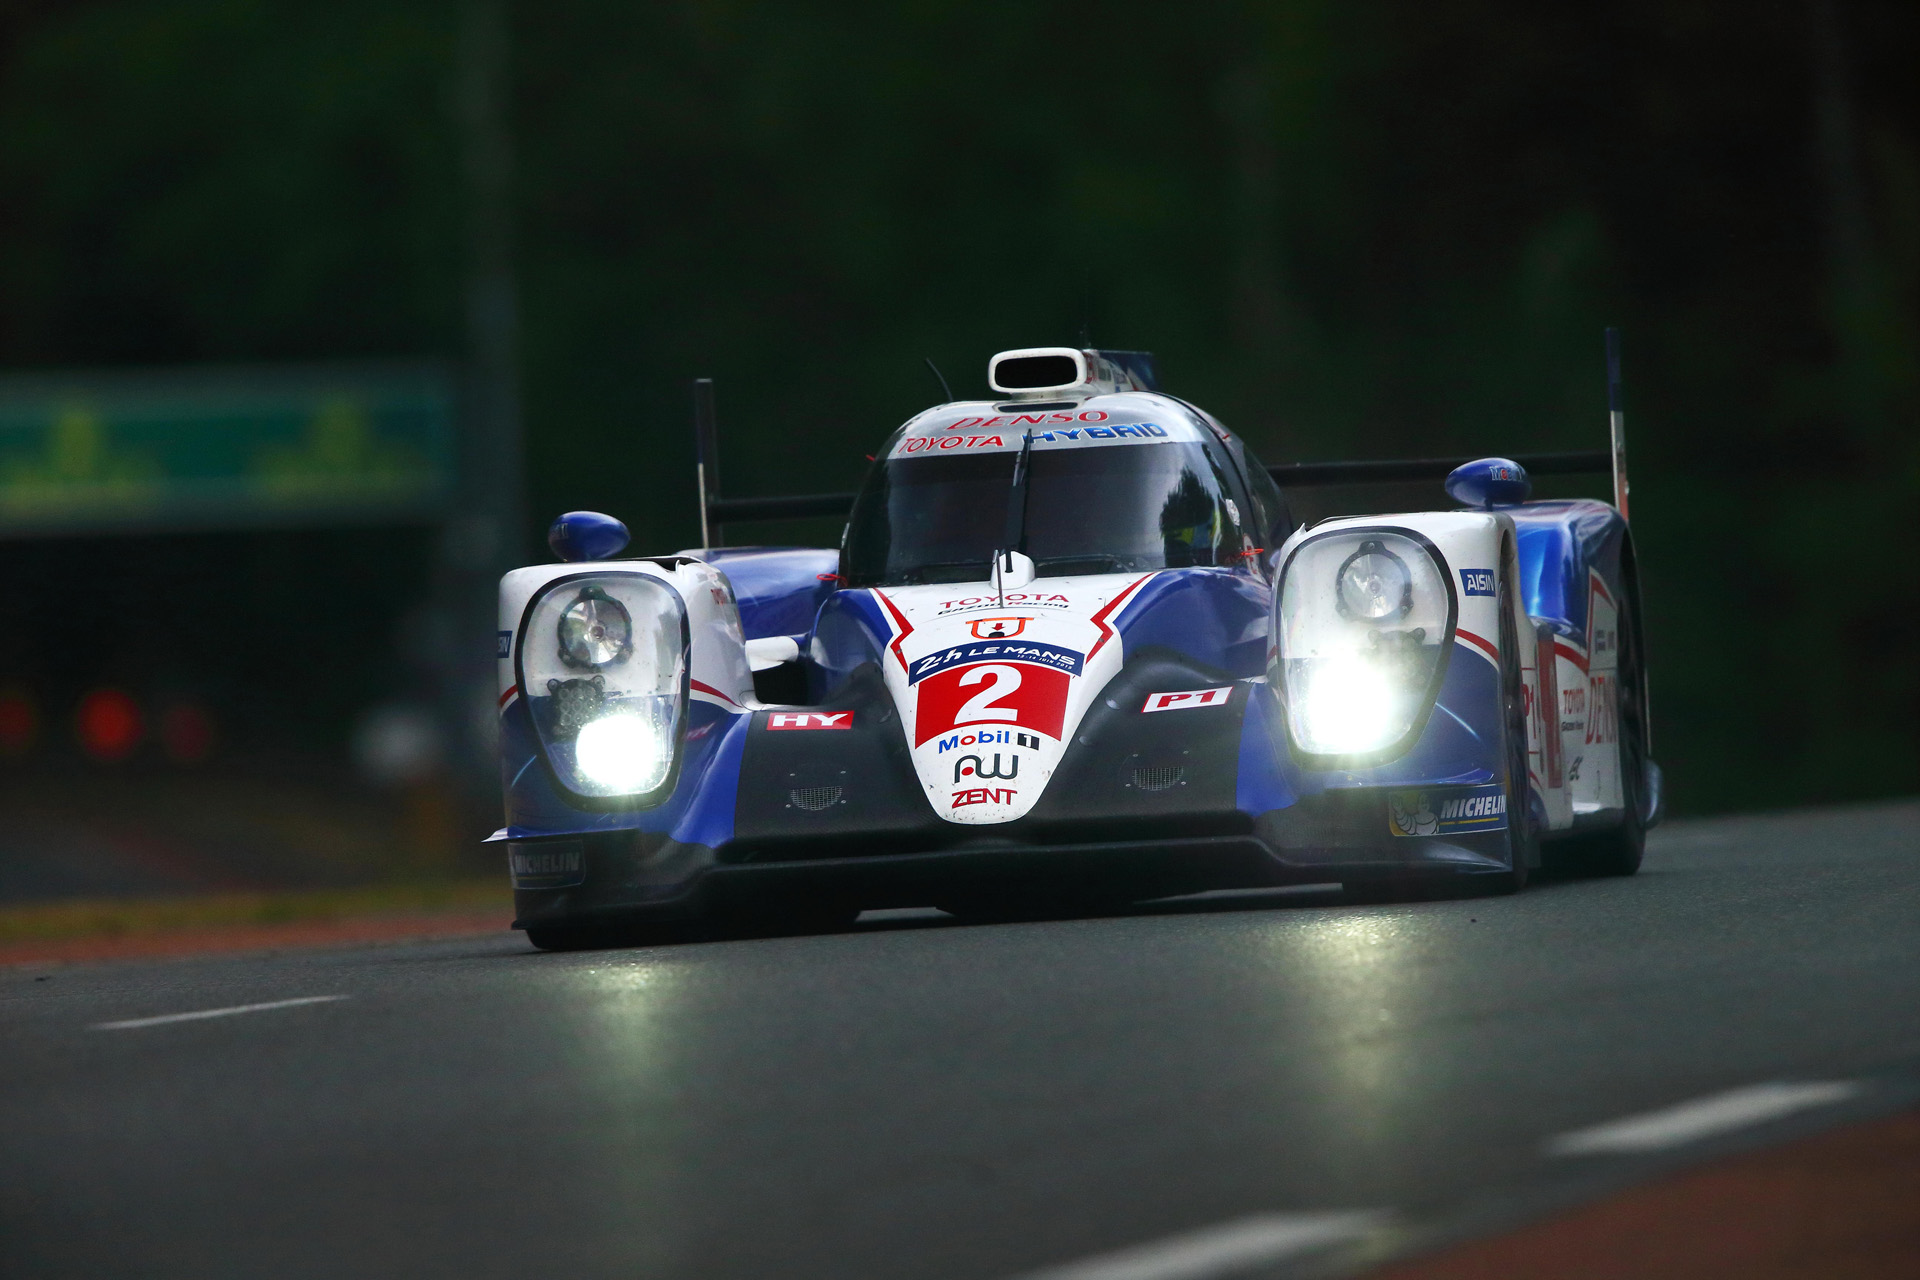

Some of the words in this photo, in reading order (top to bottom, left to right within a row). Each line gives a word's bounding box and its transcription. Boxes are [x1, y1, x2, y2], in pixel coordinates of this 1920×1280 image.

[946, 410, 1109, 431] DENSO
[898, 435, 1003, 454] TOYOTA
[1021, 422, 1169, 445] HYBRID
[1467, 573, 1495, 592] AISIN
[939, 593, 1070, 609] TOYOTA
[968, 646, 1000, 657] LE
[1003, 646, 1076, 666] MANS
[953, 664, 1022, 725] 2
[1156, 690, 1217, 708] P1
[771, 713, 850, 727] HY
[938, 730, 1010, 754] Mobil
[951, 788, 1018, 809] ZENT
[1440, 794, 1507, 819] MICHELIN
